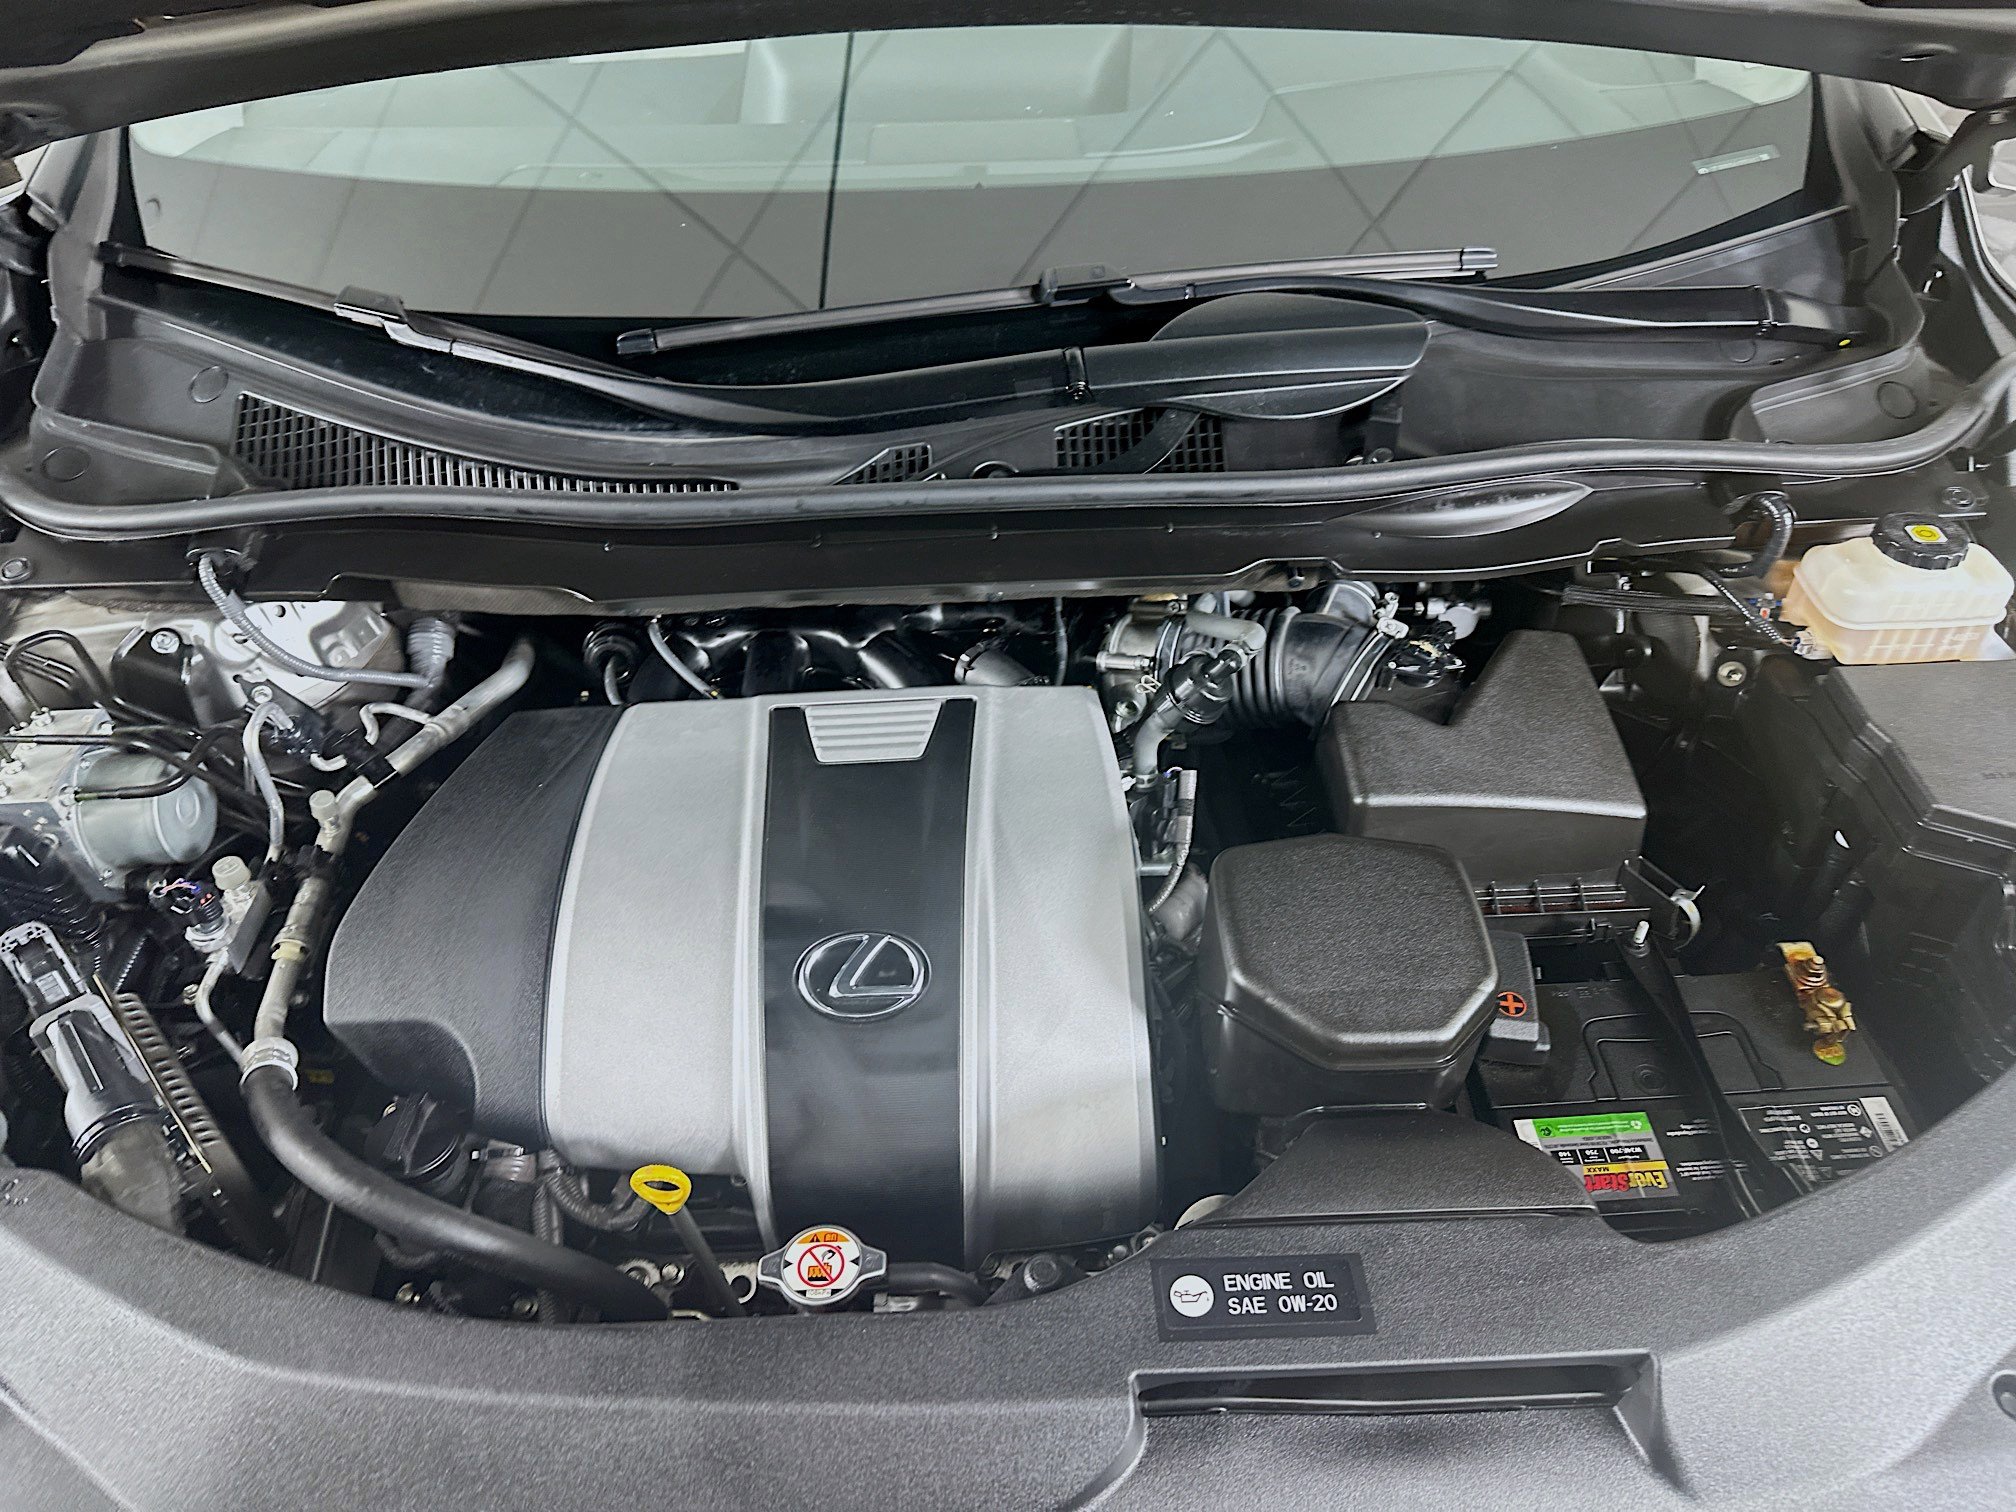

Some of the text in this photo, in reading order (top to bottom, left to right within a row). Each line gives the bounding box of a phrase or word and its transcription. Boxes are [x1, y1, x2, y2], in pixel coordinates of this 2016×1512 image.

[1584, 1172, 1668, 1192] EverStart
[1222, 1271, 1334, 1292] ENGINE OIL
[1228, 1293, 1338, 1315] SAE 0W-20
